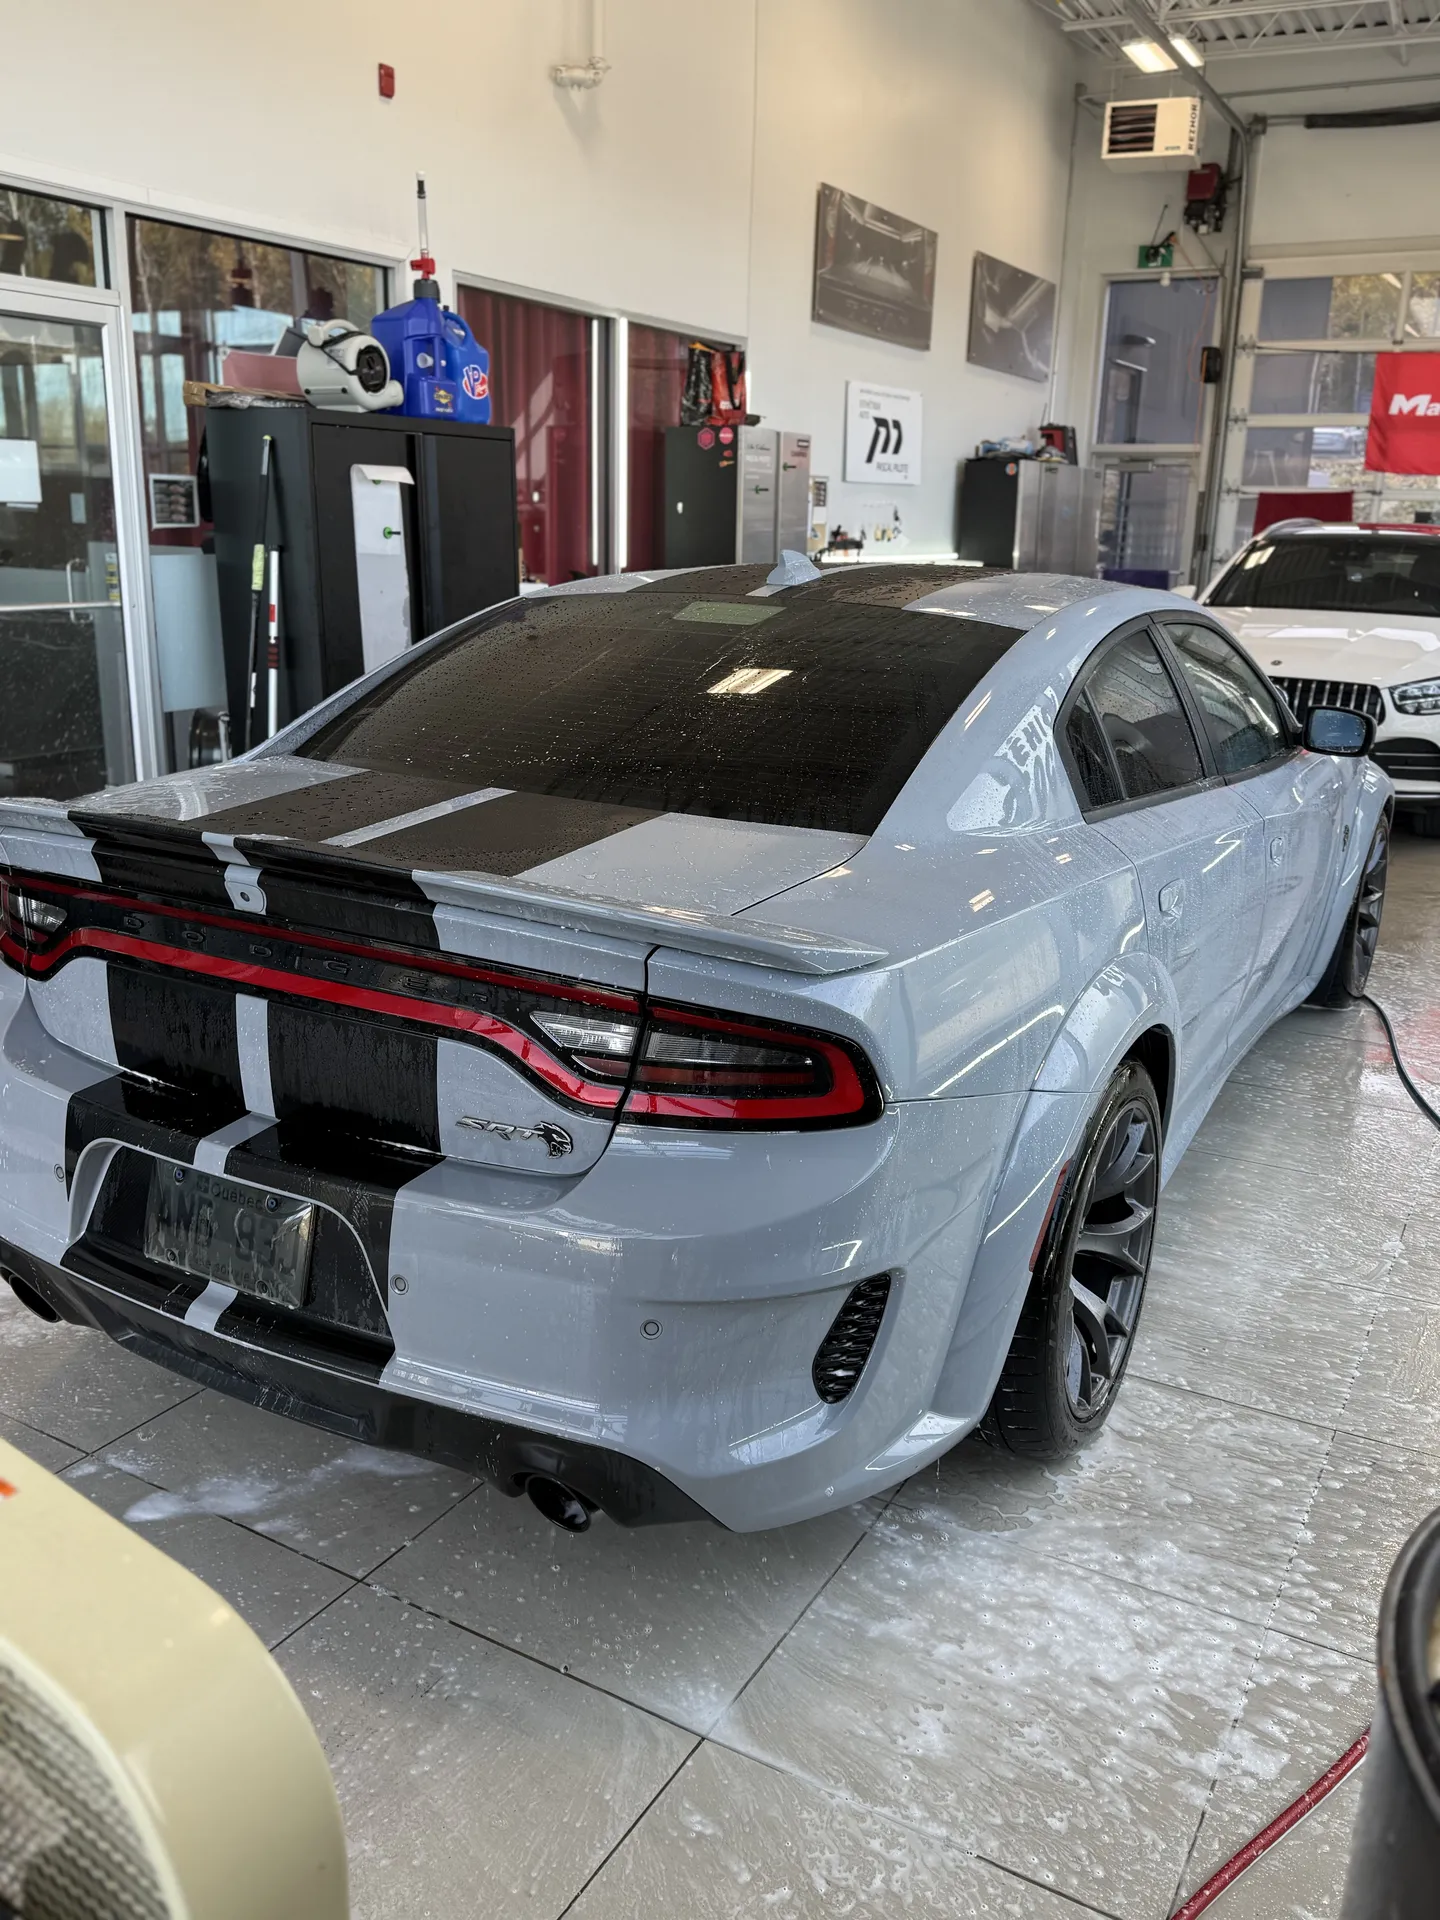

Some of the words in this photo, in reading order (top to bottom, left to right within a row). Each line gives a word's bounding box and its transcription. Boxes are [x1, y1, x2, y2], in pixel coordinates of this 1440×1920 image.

[1388, 394, 1440, 416] Ma
[123, 915, 430, 991] DODGE
[455, 1115, 544, 1141] SRT
